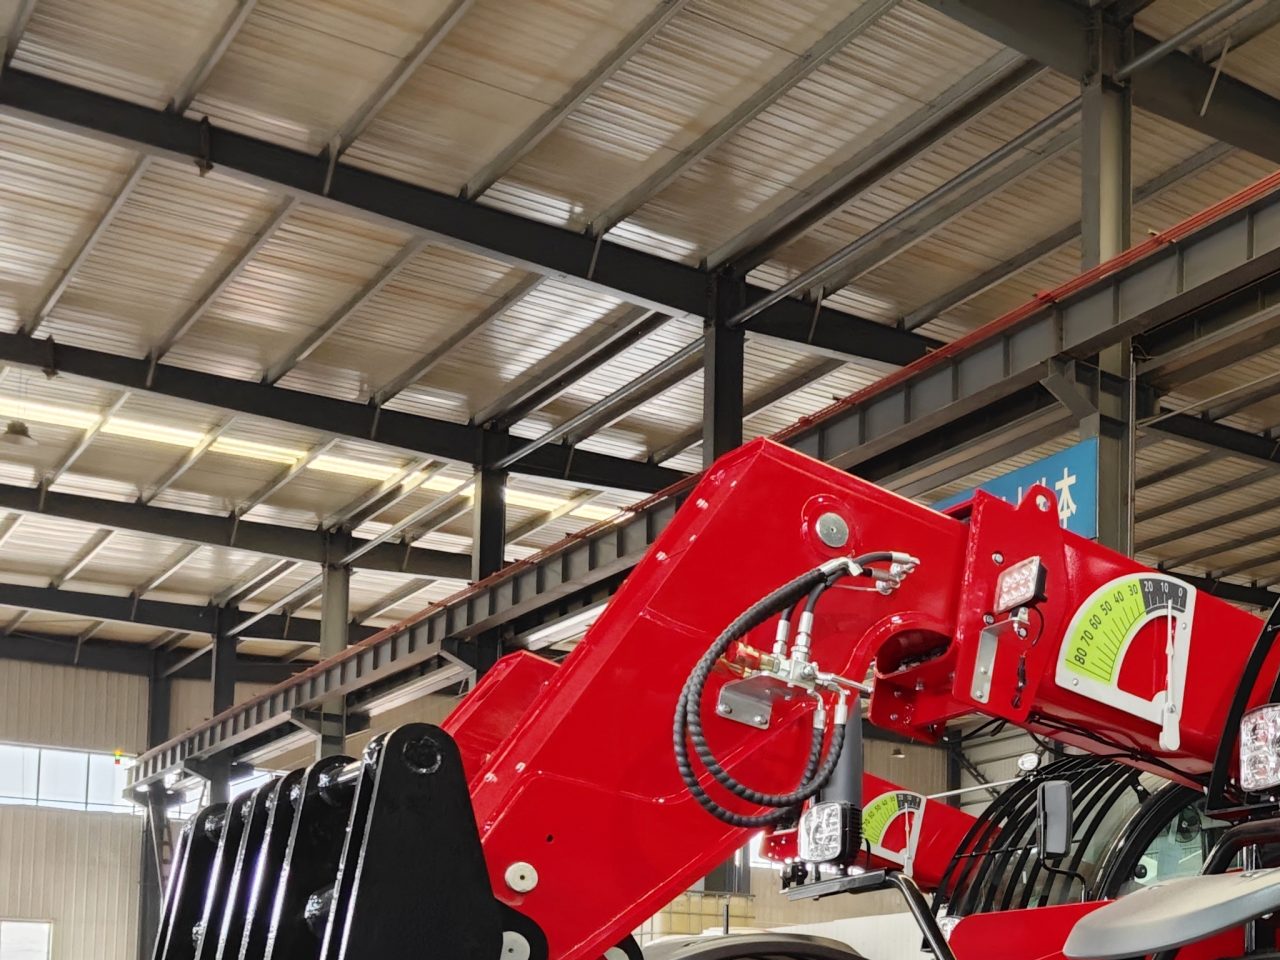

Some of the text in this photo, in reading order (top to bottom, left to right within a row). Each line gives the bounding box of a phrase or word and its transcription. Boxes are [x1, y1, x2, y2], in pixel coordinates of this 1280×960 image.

[1074, 581, 1183, 665] 80 70 60 50 40 30 20 10 0
